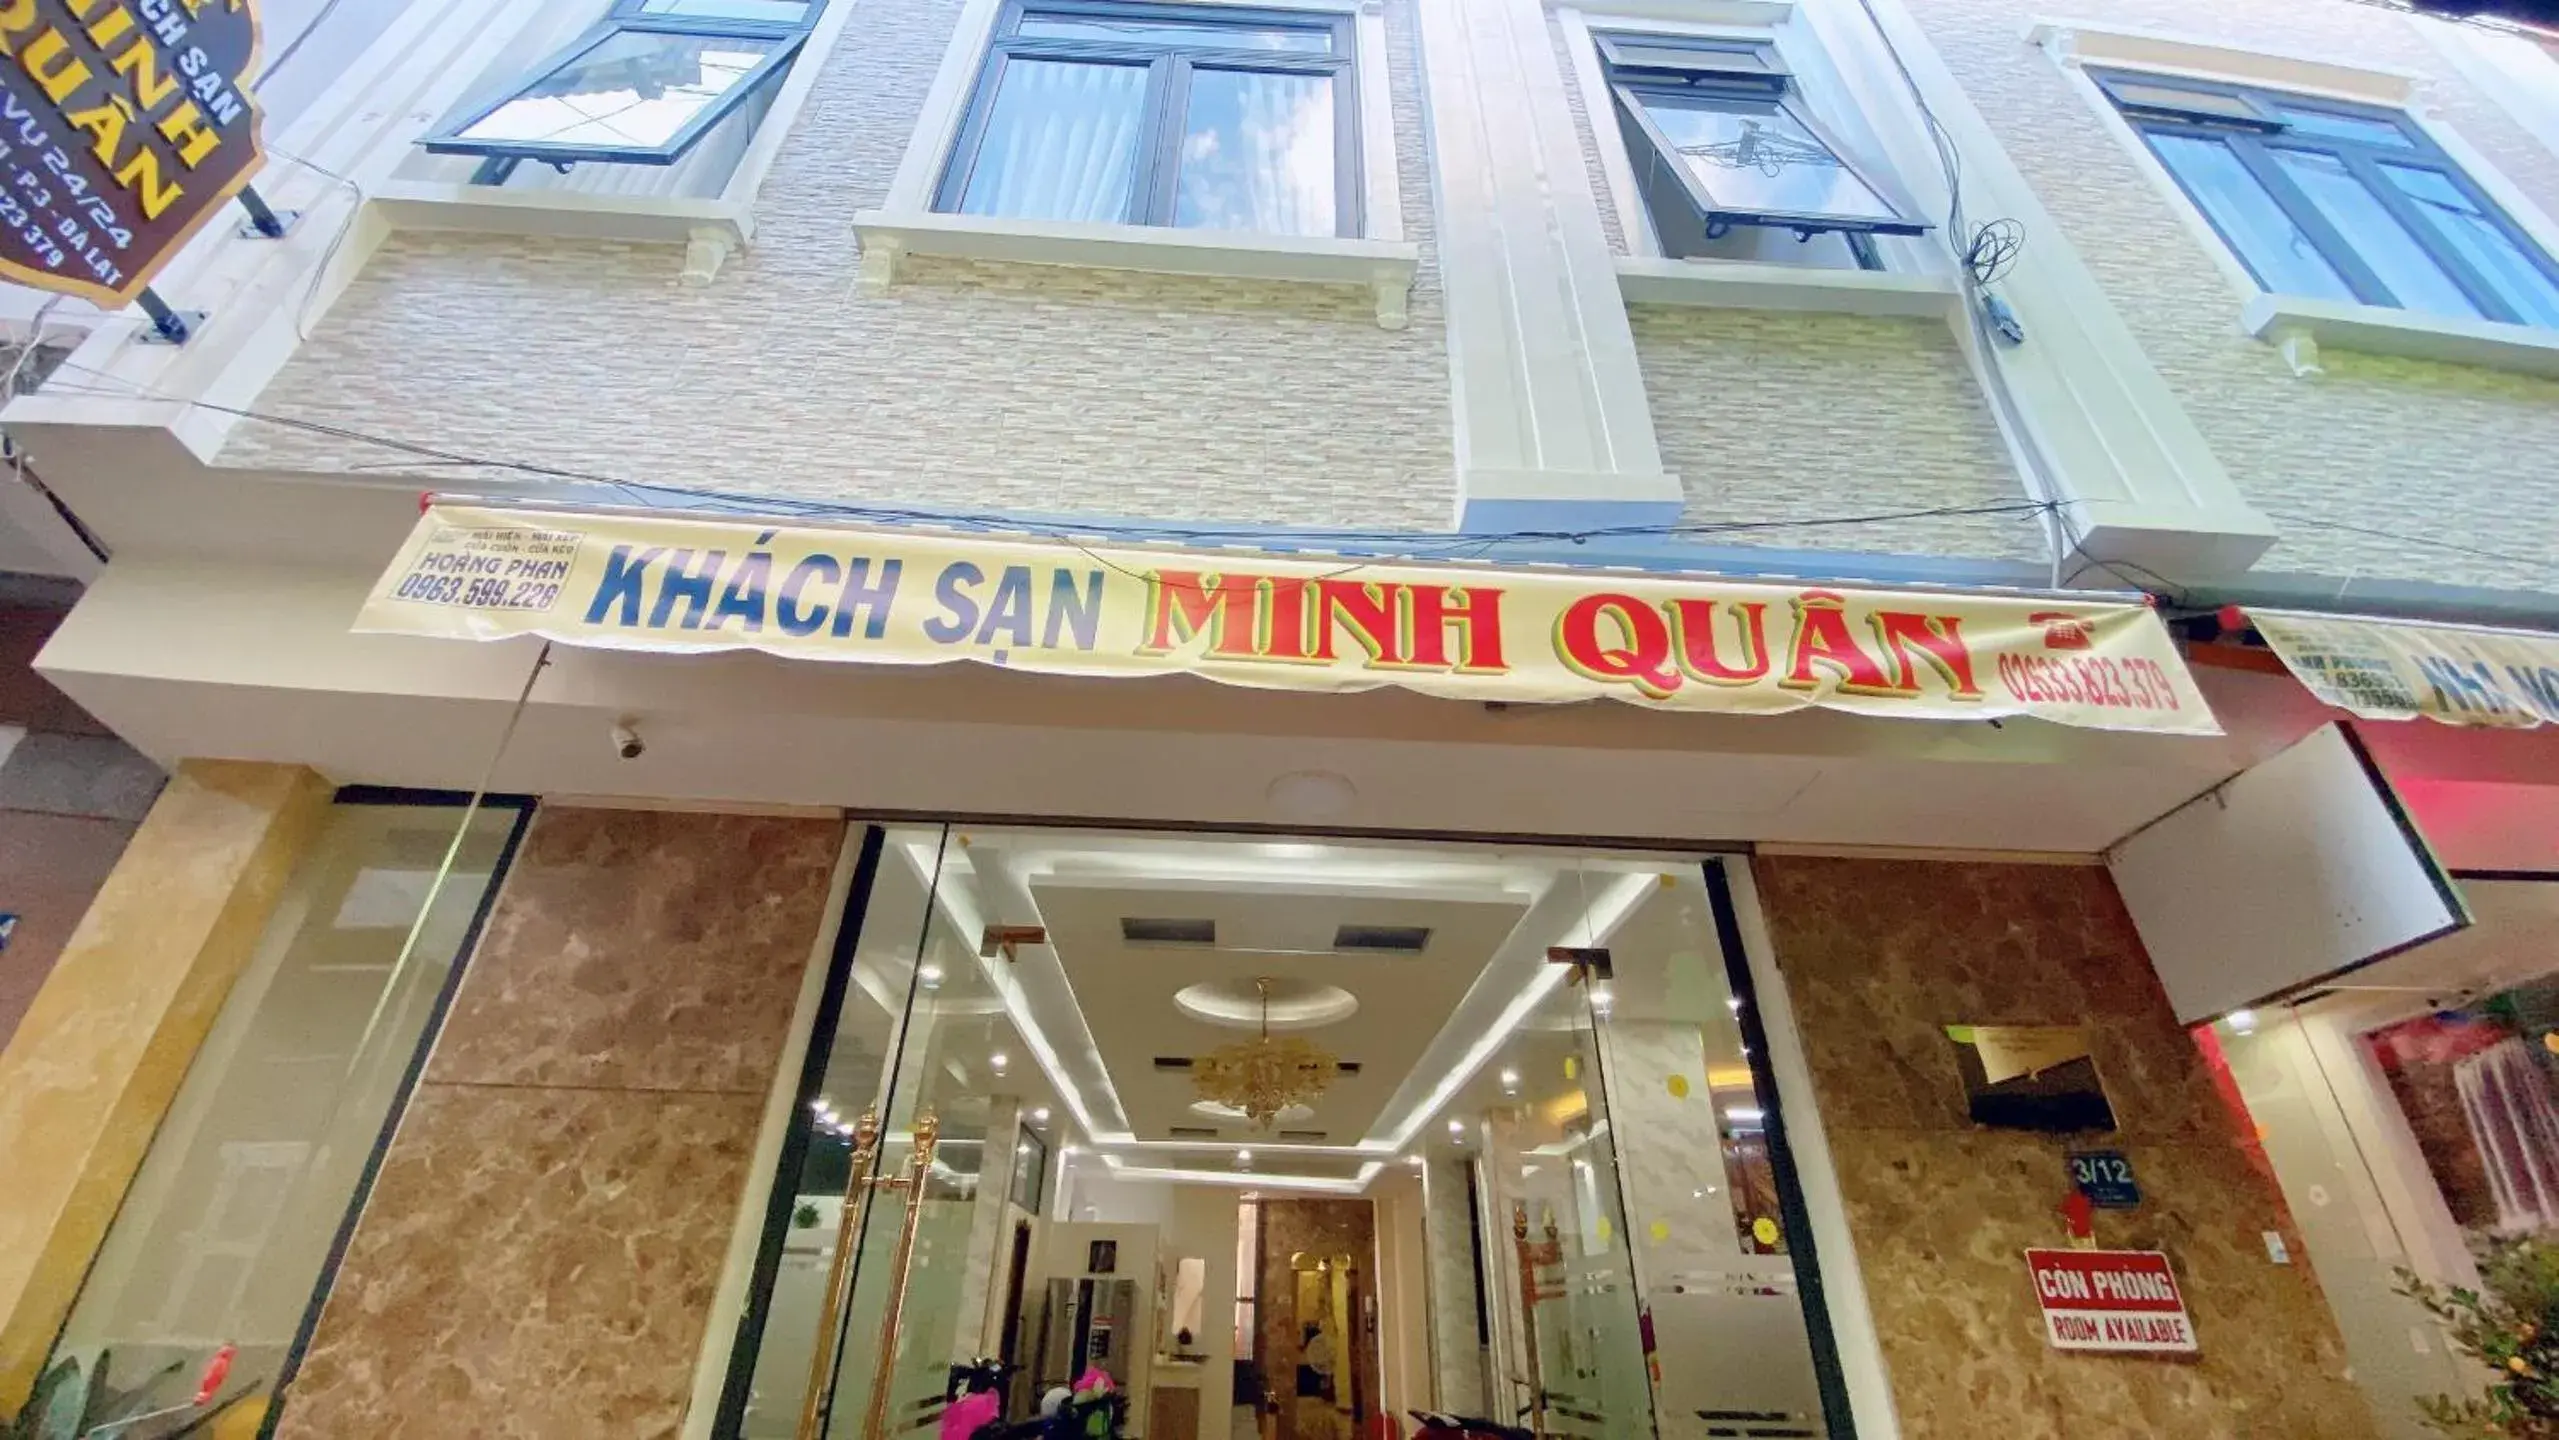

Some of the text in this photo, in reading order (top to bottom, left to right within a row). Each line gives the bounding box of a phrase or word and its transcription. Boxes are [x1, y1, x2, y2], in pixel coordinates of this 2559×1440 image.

[179, 47, 242, 126] SẠN
[42, 146, 134, 250] 24/24
[23, 224, 65, 268] 379
[418, 551, 503, 575] HOÀNG
[584, 529, 1986, 702] KHÁCH SẠN MINH QUÂN
[2072, 1158, 2133, 1185] 3/12
[2038, 1262, 2175, 1301] CÒN PHÒNG
[2052, 1315, 2187, 1344] ROOM AVAILABLE
